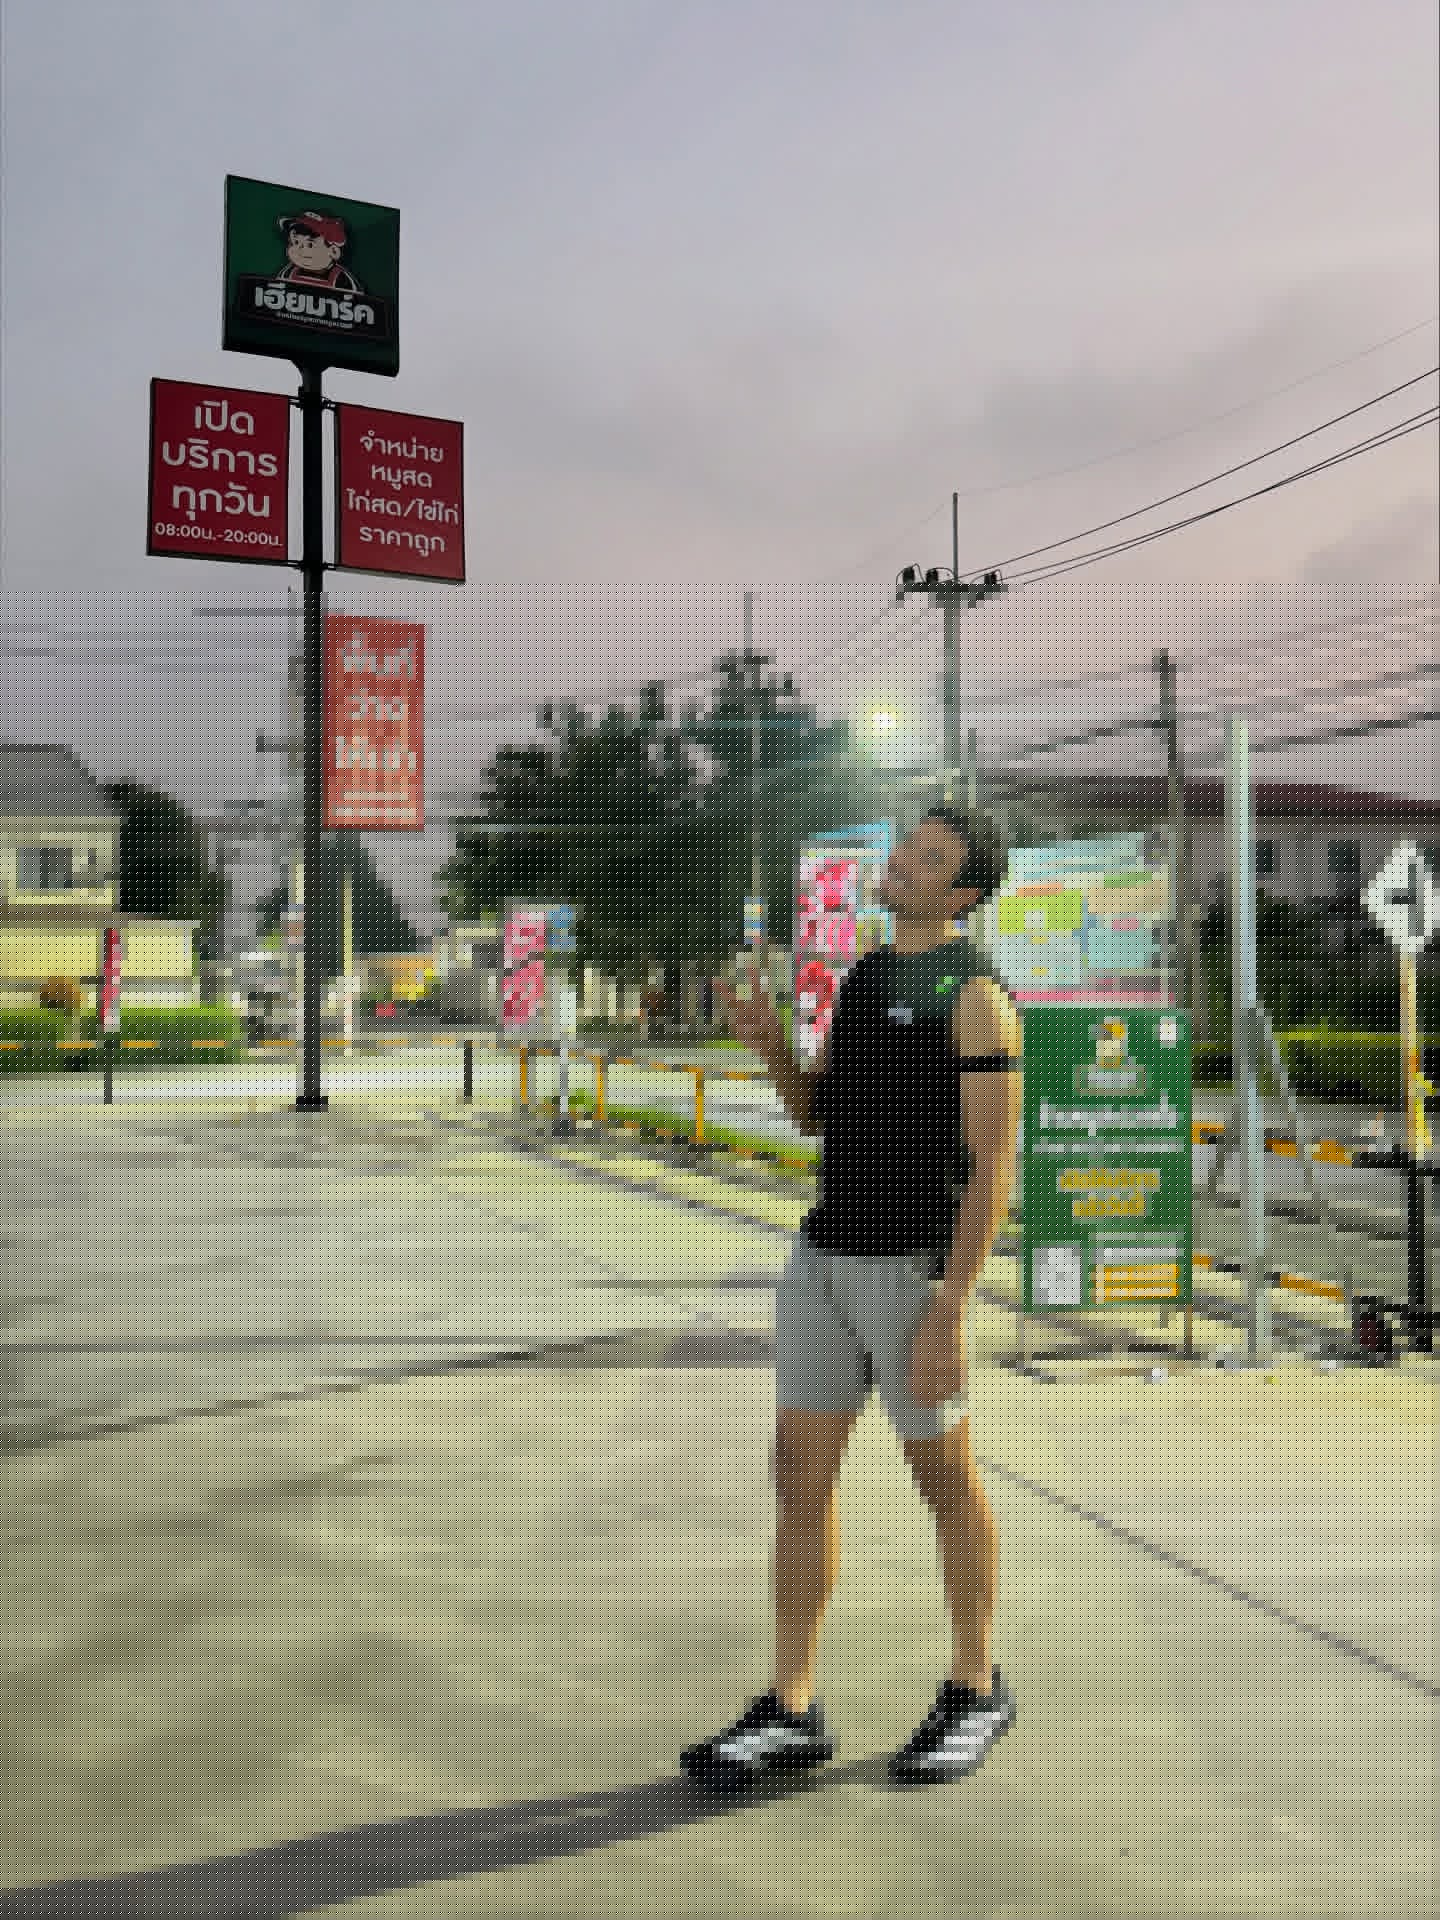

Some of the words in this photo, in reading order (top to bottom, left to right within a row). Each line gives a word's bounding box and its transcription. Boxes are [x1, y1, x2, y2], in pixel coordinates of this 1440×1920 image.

[195, 400, 255, 436] เปิด
[162, 437, 278, 477] บริการ
[359, 429, 444, 463] จำหน่าย
[370, 463, 433, 491] หมูสด
[172, 481, 270, 521] ทุกวัน
[346, 487, 459, 525] ไก่สด/ไข่ไก่
[359, 526, 446, 557] ราคาถูก
